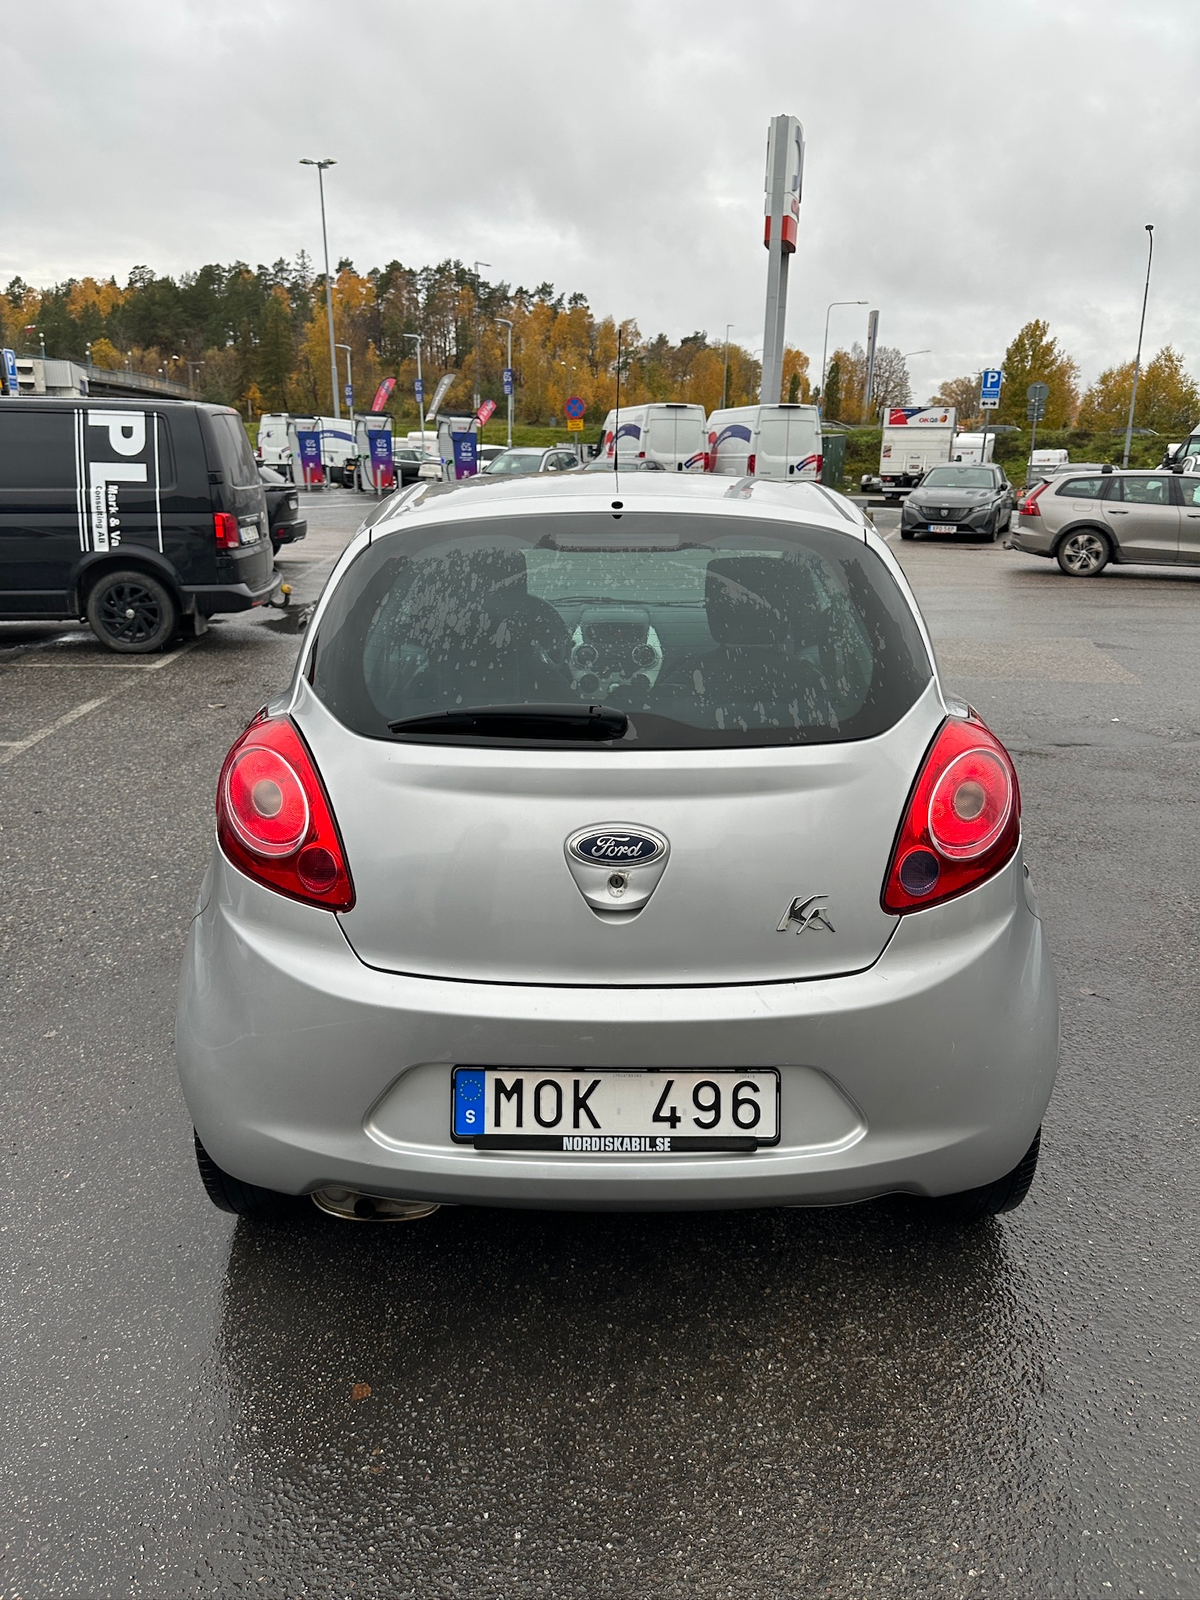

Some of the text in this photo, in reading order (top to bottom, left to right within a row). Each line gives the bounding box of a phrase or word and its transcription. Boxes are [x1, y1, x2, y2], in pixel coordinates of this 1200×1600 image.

[6, 353, 14, 374] P
[987, 373, 999, 388] P
[87, 409, 148, 552] PL
[107, 484, 119, 514] Mark
[94, 485, 106, 544] Consulting AB
[109, 517, 120, 527] &
[591, 835, 643, 857] Ford
[494, 1077, 761, 1130] MOK 496
[465, 1109, 476, 1124] S
[562, 1136, 671, 1152] NORDISKABIL.SE
